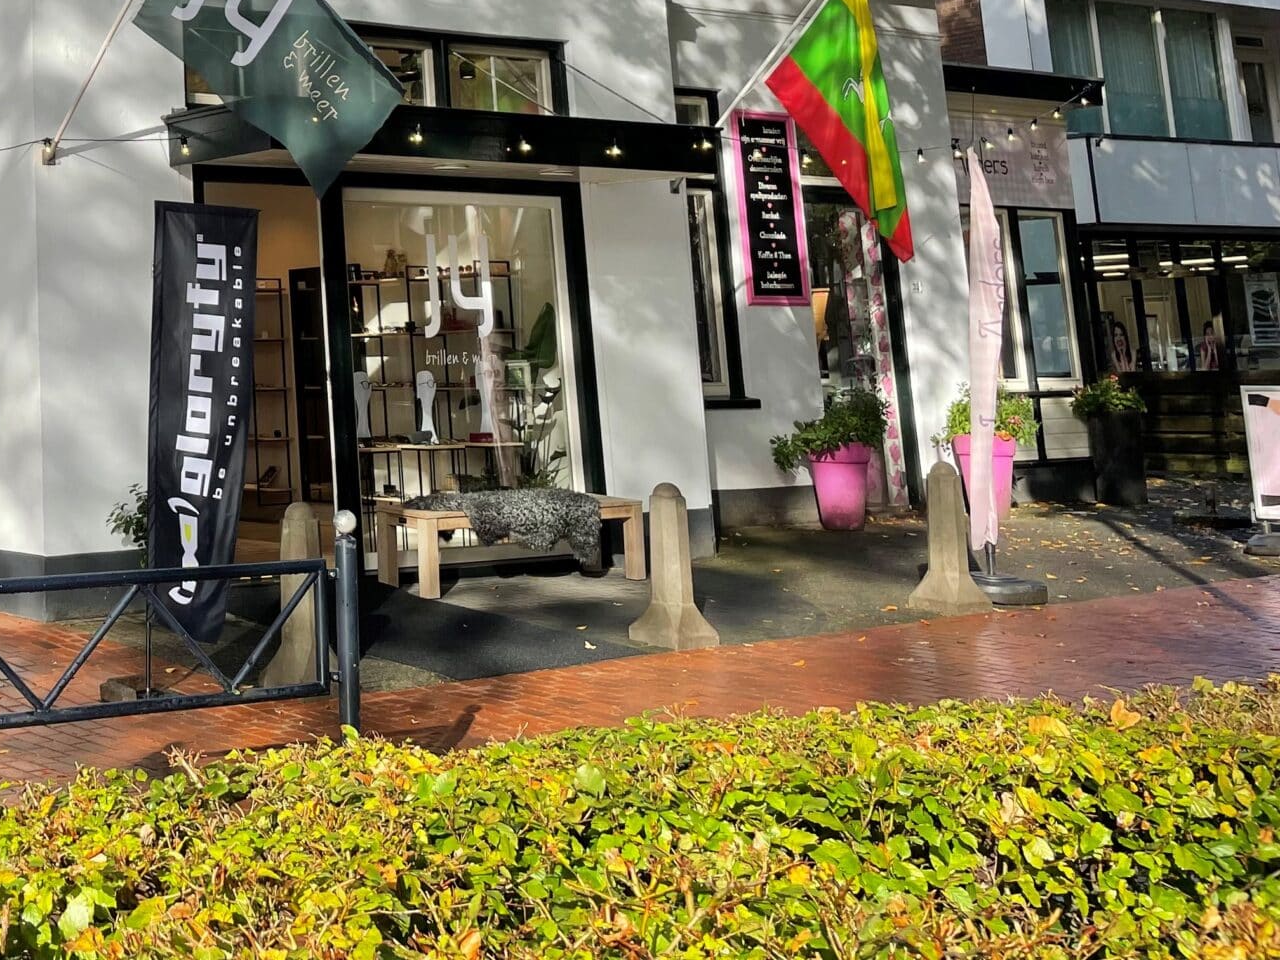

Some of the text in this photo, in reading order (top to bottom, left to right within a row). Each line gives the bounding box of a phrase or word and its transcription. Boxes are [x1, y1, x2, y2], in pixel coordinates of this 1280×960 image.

[291, 29, 352, 102] brillen
[298, 70, 339, 122] meer
[175, 243, 228, 497] gloryfy
[212, 245, 244, 500] be unbreakable
[425, 348, 459, 366] brillen
[462, 351, 469, 366] &
